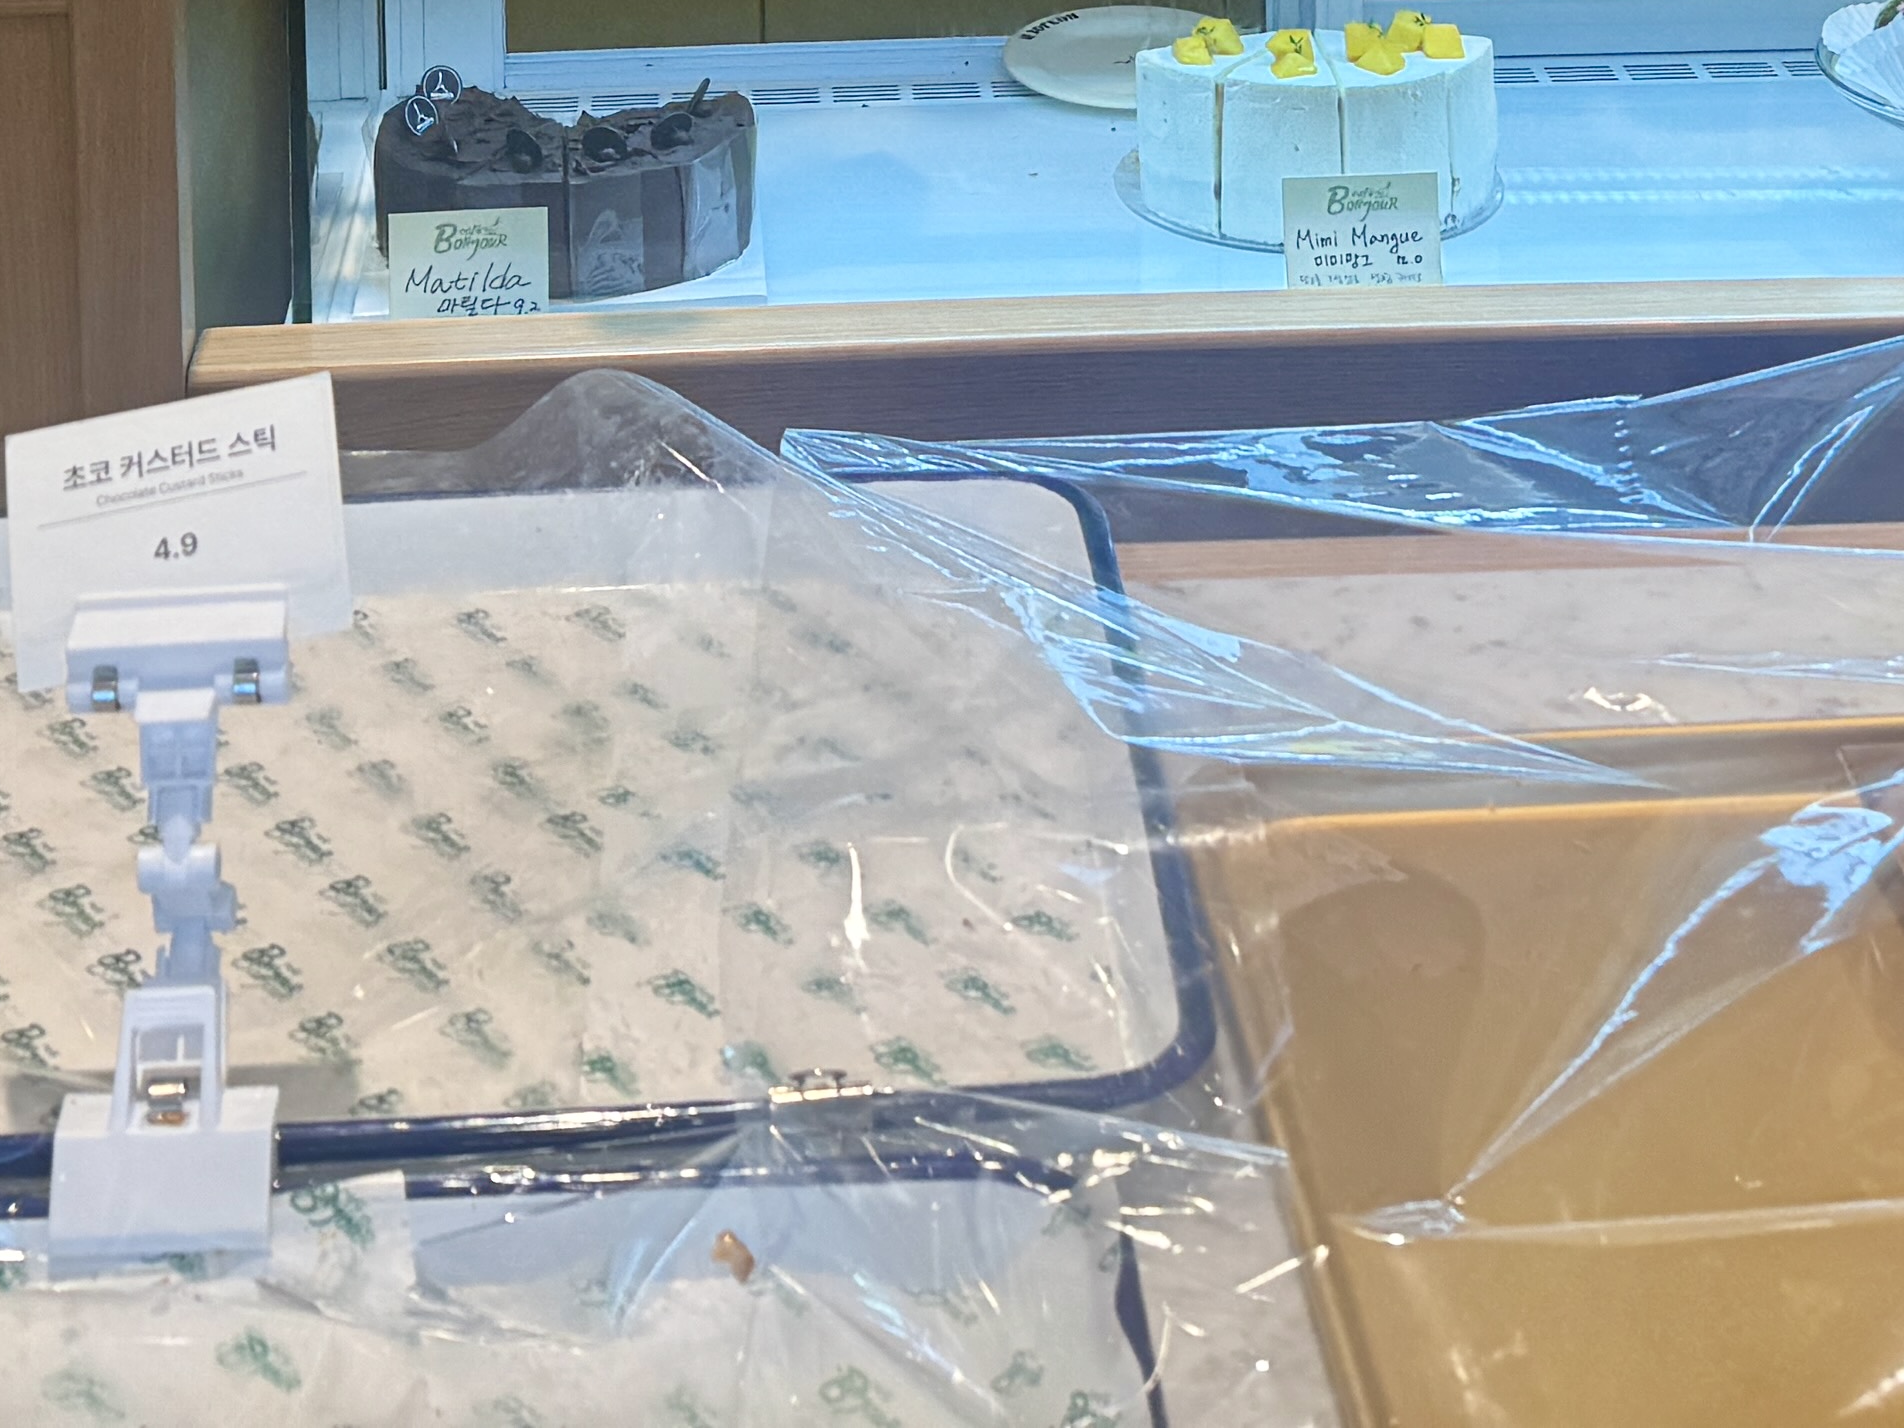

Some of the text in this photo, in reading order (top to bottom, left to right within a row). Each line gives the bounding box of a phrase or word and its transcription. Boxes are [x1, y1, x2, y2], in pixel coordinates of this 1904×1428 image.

[1296, 223, 1423, 254] Mimi Mangue
[405, 262, 532, 294] Matilda
[437, 295, 541, 316] 마틸다 9.2
[63, 424, 276, 491] 초코 커스터드 스틱
[96, 486, 156, 508] Chocolate
[153, 531, 199, 561] 4.9
